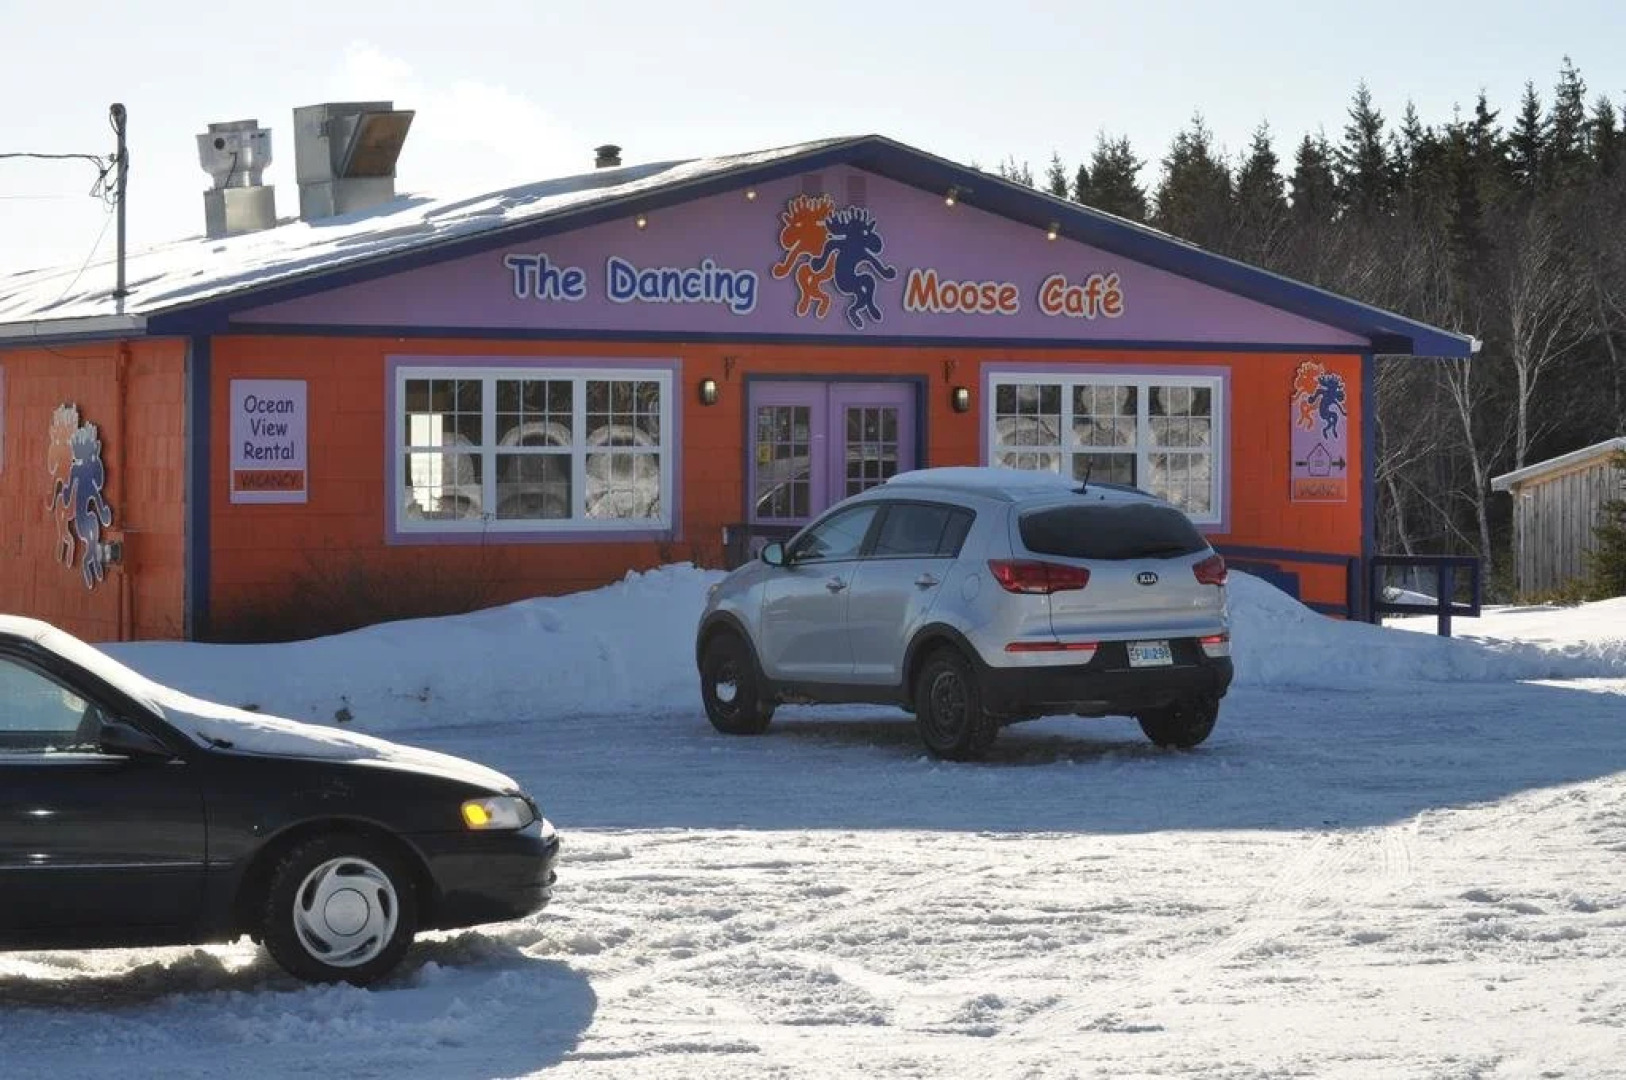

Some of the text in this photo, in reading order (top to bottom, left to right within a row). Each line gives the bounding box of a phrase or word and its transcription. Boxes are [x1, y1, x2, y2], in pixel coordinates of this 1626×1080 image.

[506, 254, 1122, 318] The Dancing Moose Café
[243, 394, 295, 414] Ocean
[250, 418, 288, 437] View
[243, 442, 296, 460] Rental
[1139, 573, 1158, 584] KIA
